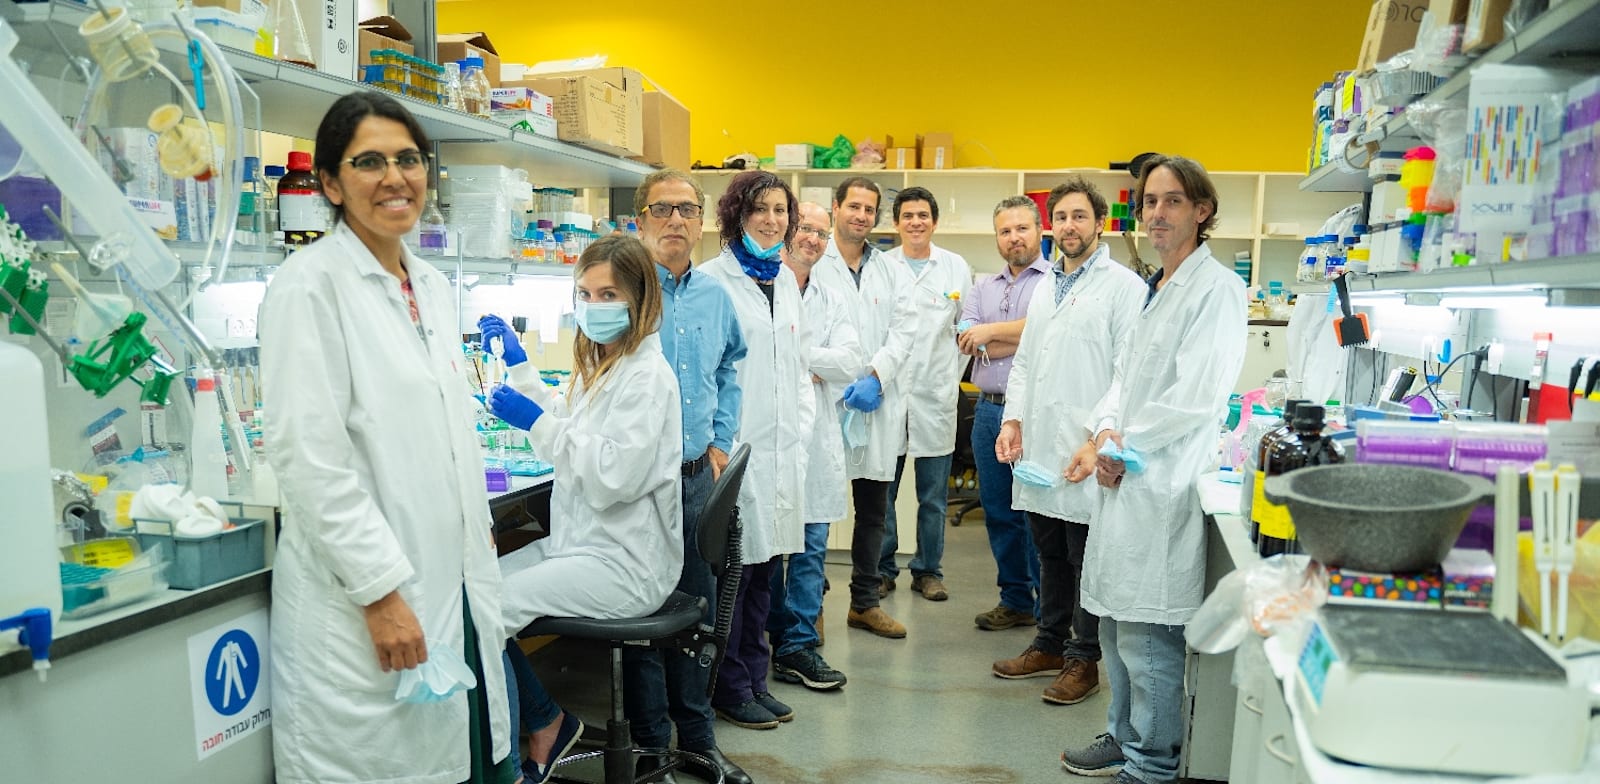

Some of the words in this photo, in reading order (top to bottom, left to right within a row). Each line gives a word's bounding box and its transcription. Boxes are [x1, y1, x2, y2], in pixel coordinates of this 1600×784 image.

[252, 708, 271, 728] חלוק
[225, 718, 250, 740] עבודה
[202, 733, 224, 752] חובה
